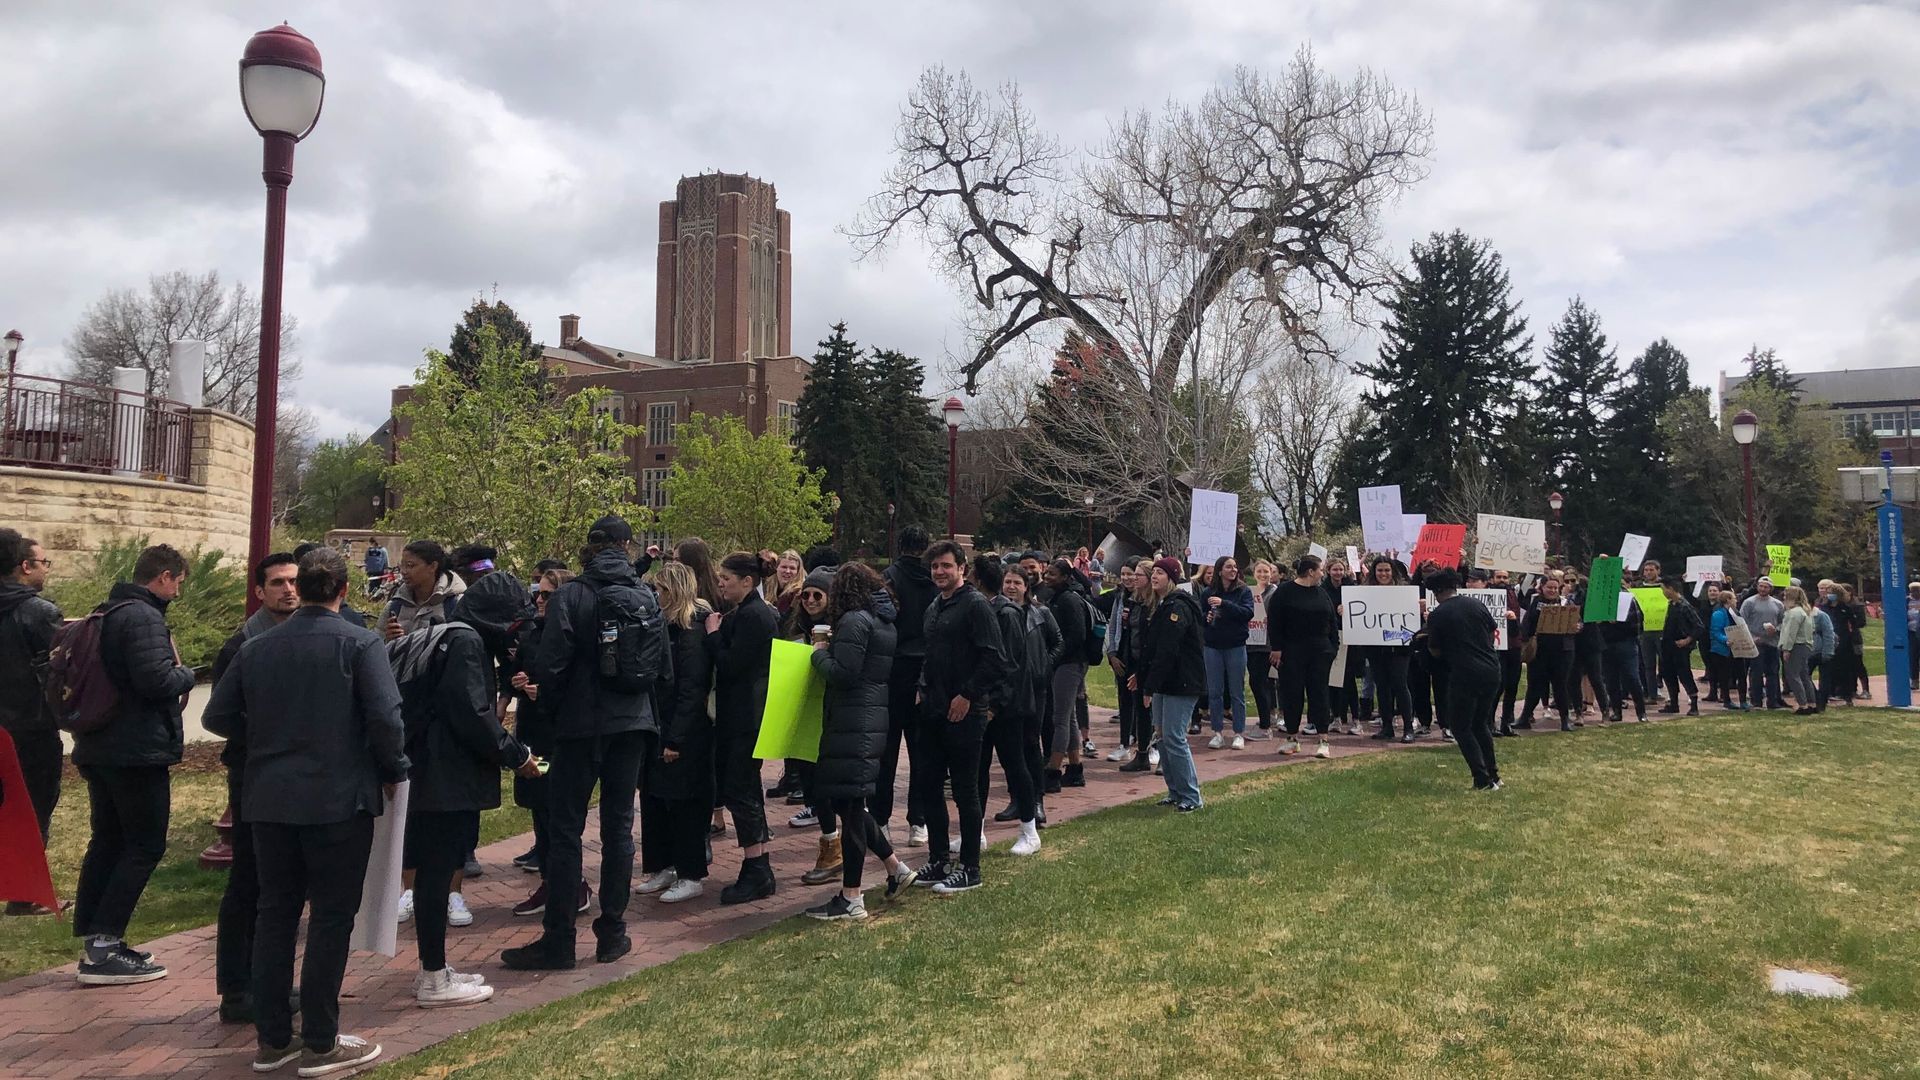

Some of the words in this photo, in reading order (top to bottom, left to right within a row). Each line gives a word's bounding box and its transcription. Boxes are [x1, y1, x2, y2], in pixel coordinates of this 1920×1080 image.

[1487, 518, 1534, 537] PROTECT
[1771, 547, 1783, 556] ALL
[1889, 518, 1898, 588] ASSISTANCE
[1498, 594, 1506, 607] IN
[1348, 600, 1415, 629] Purrr
